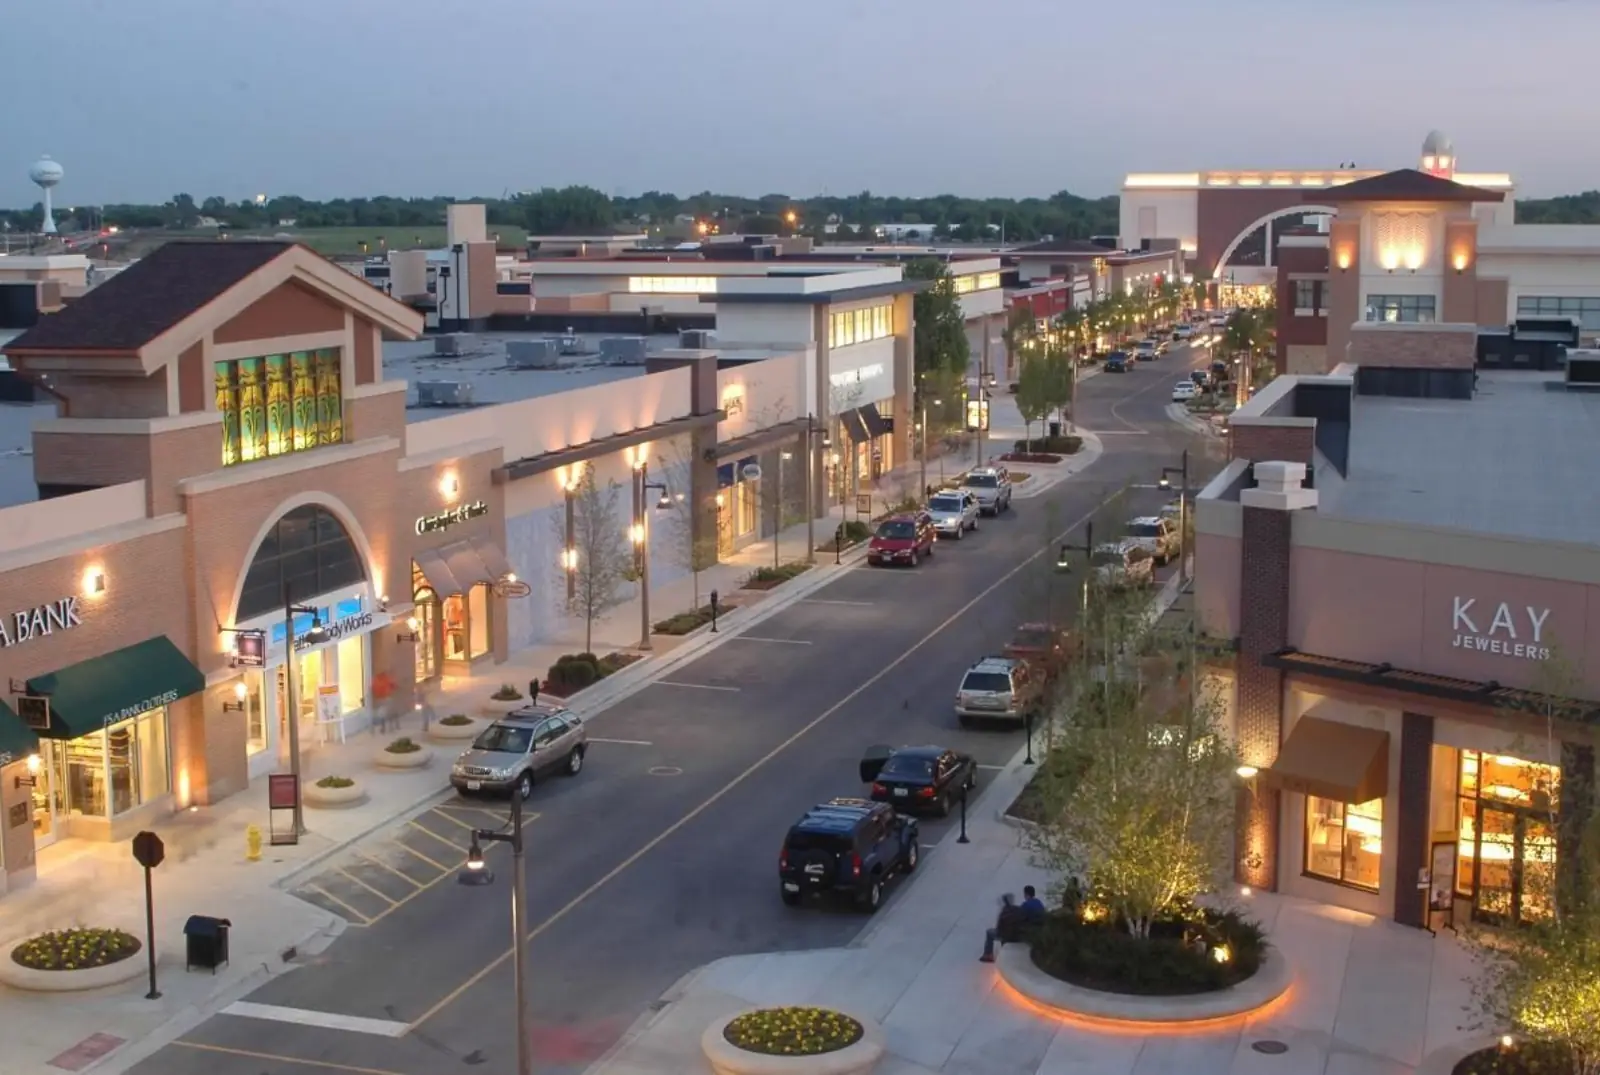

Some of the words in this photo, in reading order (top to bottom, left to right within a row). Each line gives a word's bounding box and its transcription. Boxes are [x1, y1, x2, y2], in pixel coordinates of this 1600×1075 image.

[14, 595, 82, 643] BANK
[1453, 595, 1551, 643] KAY
[1452, 634, 1550, 660] JEWELERS
